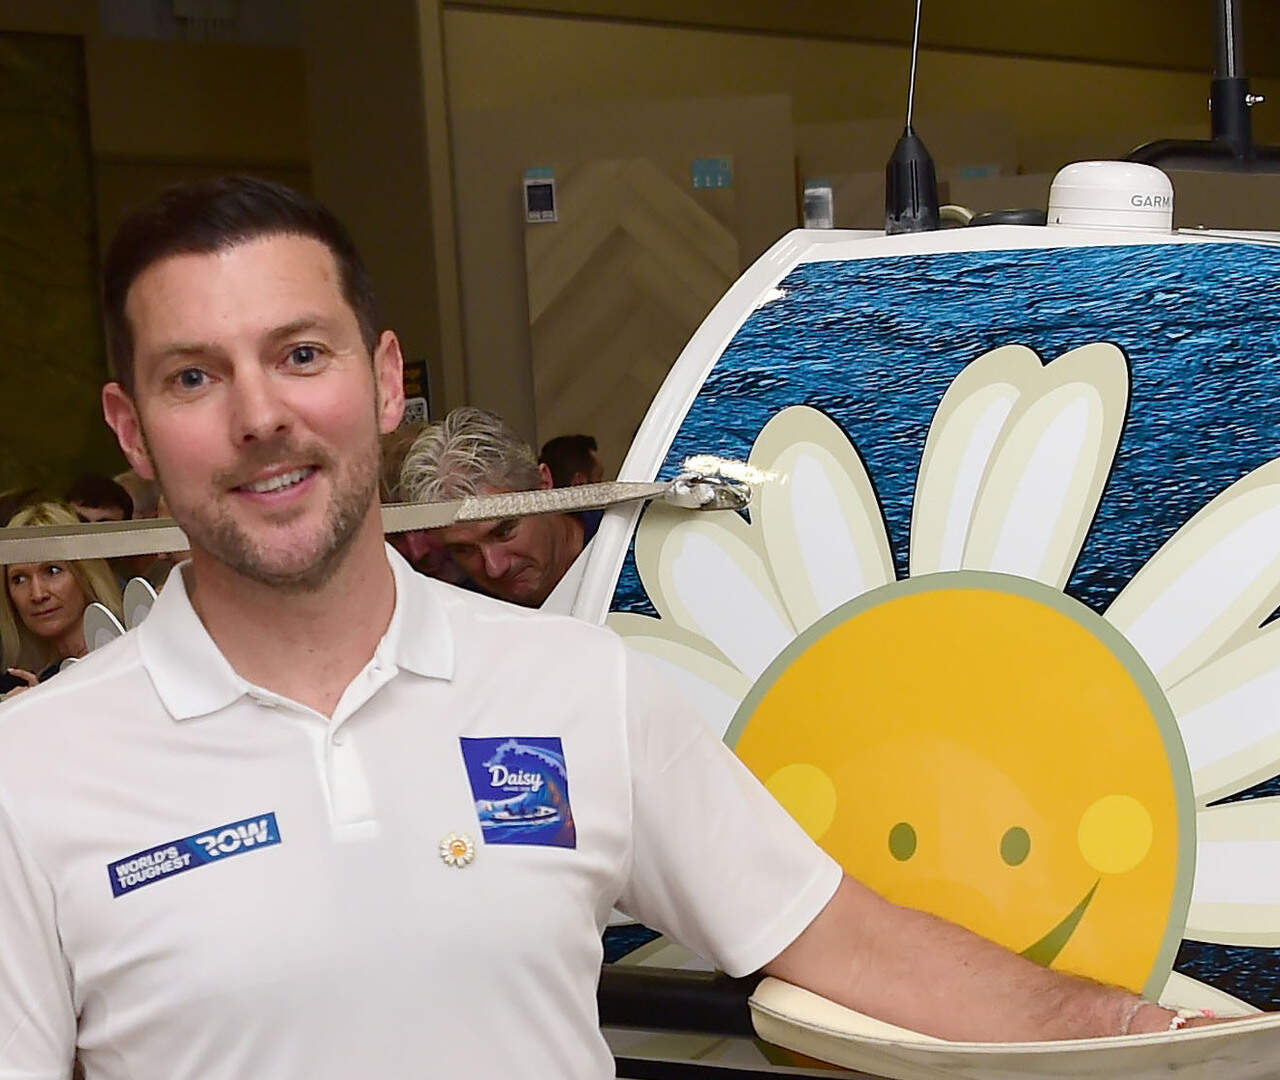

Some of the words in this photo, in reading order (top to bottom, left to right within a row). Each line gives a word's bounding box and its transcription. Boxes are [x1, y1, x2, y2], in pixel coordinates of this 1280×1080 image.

[1131, 194, 1170, 207] GARM
[488, 764, 545, 792] Daisy
[115, 846, 179, 876] WORLD'S
[118, 853, 192, 889] TOUGHEST
